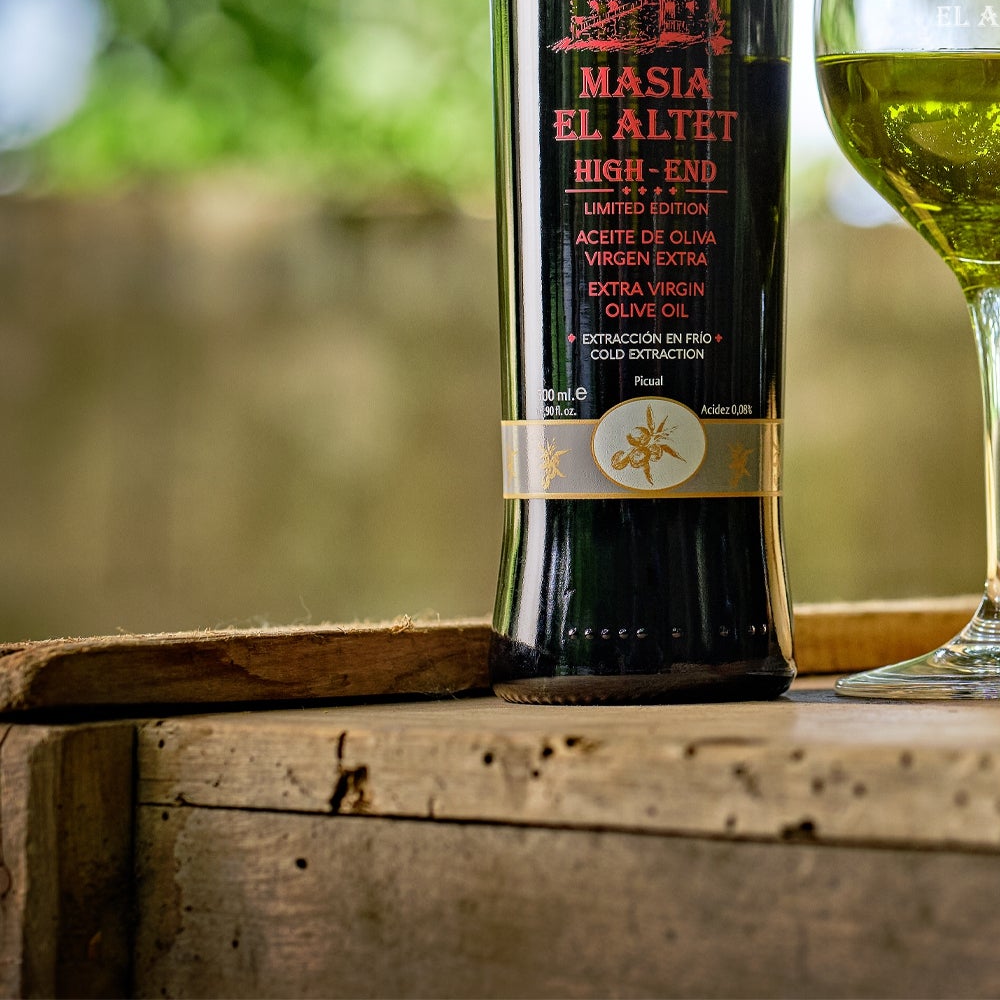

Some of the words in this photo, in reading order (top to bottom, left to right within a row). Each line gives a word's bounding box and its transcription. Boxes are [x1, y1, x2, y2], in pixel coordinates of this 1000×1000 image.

[936, 5, 969, 27] EL
[579, 66, 714, 99] MASIA
[553, 109, 602, 141] EL
[612, 108, 738, 142] ALTET
[584, 202, 645, 216] LIMITED
[650, 202, 709, 216] EDITION
[575, 230, 635, 245] ACEITE
[641, 230, 665, 245] DE
[669, 230, 717, 245] OLIVA
[584, 251, 650, 266] VIRGEN
[656, 251, 708, 266] EXTRA
[588, 282, 644, 297] EXTRA
[647, 282, 705, 297] VIRGIN
[605, 303, 656, 318] OLIVE
[661, 303, 689, 318] OIL
[582, 331, 662, 344] EXTRACCIÓN
[666, 333, 683, 344] EN
[685, 331, 712, 344] FRÍO
[590, 349, 625, 360] COLD
[628, 349, 705, 360] EXTRACTION
[634, 375, 664, 387] Picual
[537, 388, 555, 402] 00
[564, 407, 577, 416] oz.
[700, 403, 731, 415] Acidez
